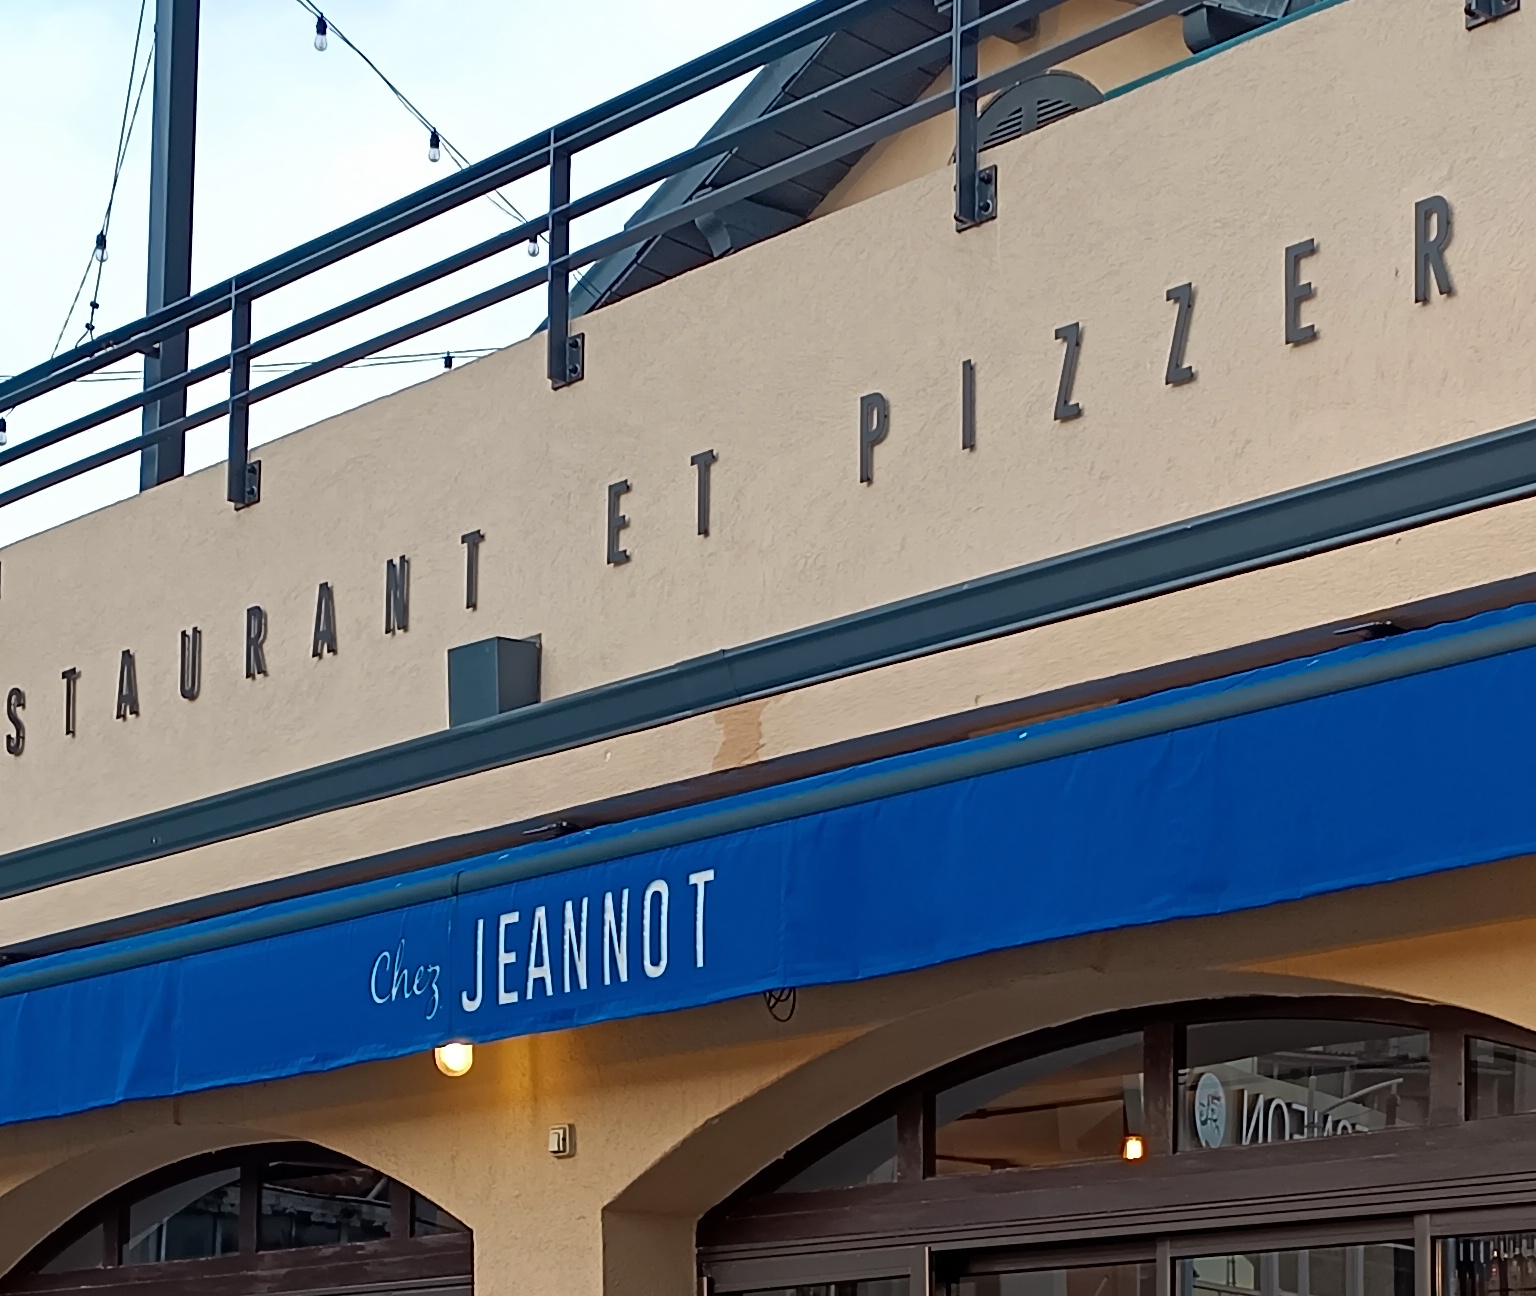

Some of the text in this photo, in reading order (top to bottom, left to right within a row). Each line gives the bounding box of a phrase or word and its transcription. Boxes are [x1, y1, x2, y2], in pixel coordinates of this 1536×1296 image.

[607, 449, 718, 565] ET
[371, 869, 716, 1020] Chez JEANNOT
